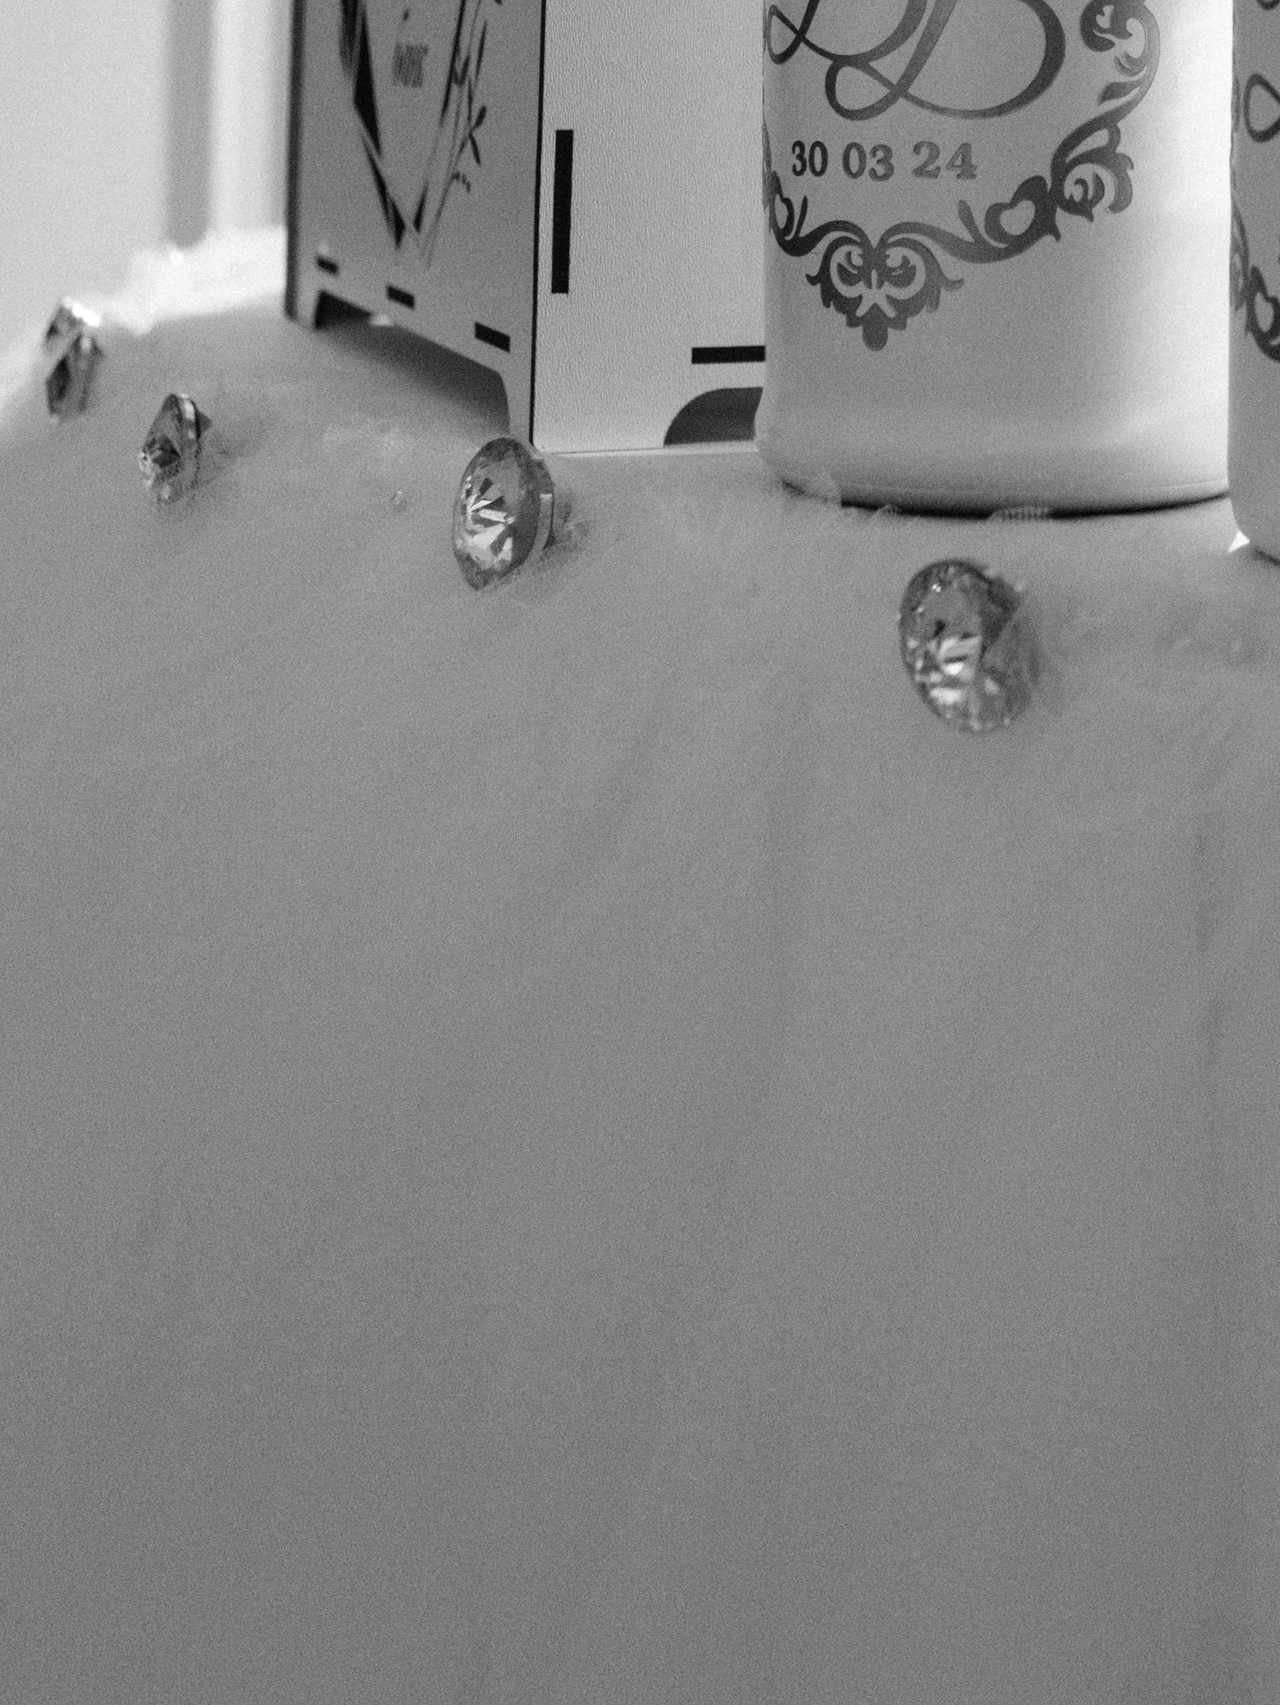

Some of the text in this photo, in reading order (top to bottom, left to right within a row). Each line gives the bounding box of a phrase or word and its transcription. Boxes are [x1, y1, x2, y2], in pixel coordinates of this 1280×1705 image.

[790, 139, 978, 182] 30 03 24
